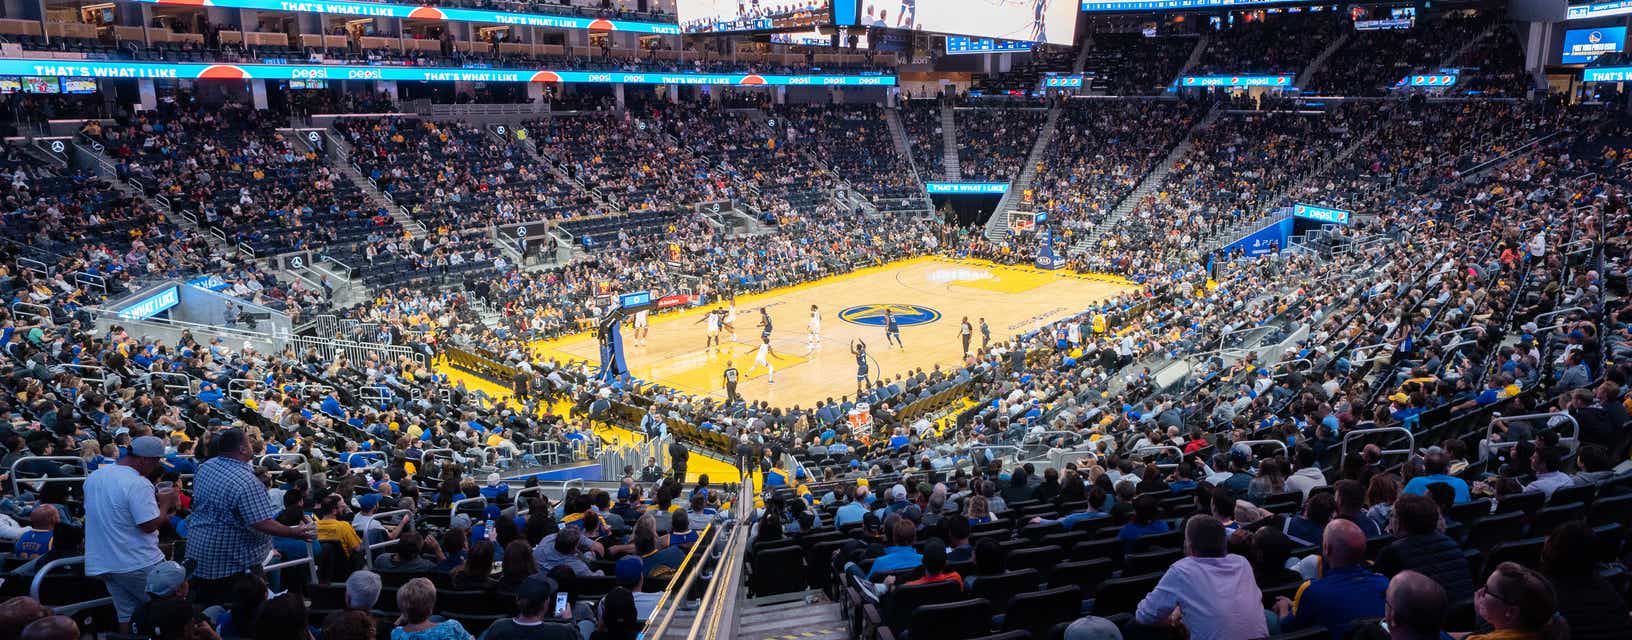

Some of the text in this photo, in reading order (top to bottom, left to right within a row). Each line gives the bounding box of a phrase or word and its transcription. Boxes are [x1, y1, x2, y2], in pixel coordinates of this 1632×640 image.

[280, 1, 324, 13] THAT'S
[326, 4, 361, 15] WHAT
[369, 7, 394, 17] LIKE
[496, 15, 527, 25] THAT'S
[528, 17, 553, 26] WHAT
[559, 20, 577, 28] LIKE
[651, 26, 676, 35] THAT'S
[33, 65, 91, 77] THAT'S
[93, 67, 136, 78] WHAT
[147, 68, 177, 78] LIKE
[292, 67, 382, 80] pepsi pepsi
[1592, 72, 1623, 81] THAT'S
[423, 72, 460, 81] THAT'S
[460, 73, 491, 81] WHAT
[497, 74, 518, 82] LIKE
[588, 74, 645, 83] pepsi pepsi
[789, 77, 881, 85] pepsi pepsi pepsi
[1201, 77, 1269, 86] pepsi pepsi
[959, 184, 981, 192] WHAT
[987, 184, 1004, 192] LIKE
[1309, 209, 1333, 221] pepsi
[131, 302, 154, 320] WHAT
[159, 291, 175, 307] LIKE
